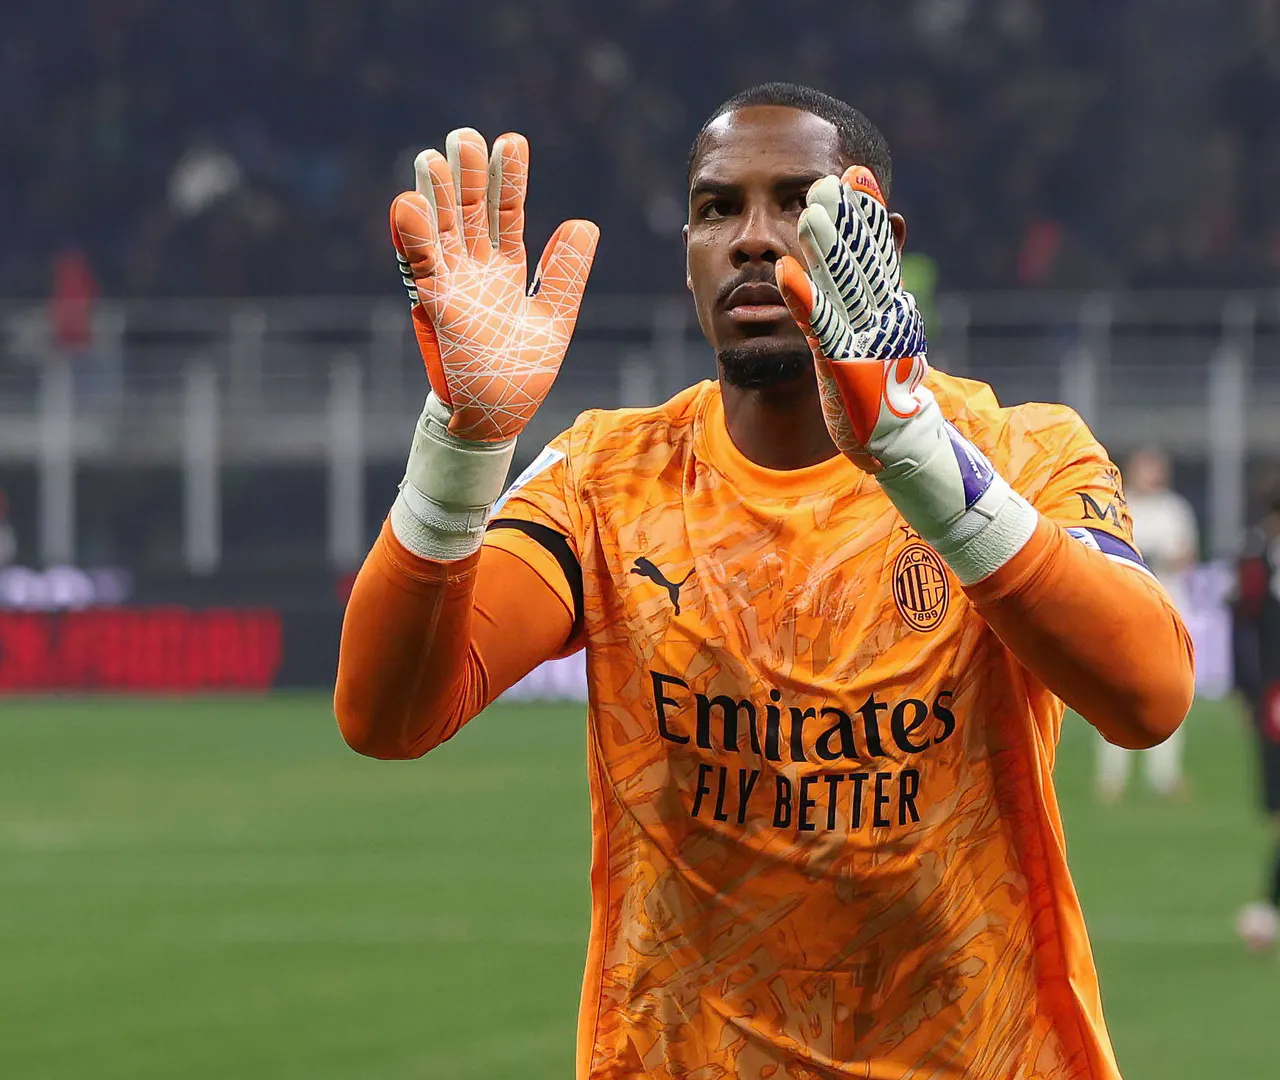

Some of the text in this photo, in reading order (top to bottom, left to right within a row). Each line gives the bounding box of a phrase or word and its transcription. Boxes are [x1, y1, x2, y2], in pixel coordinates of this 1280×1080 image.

[903, 551, 933, 570] ACM
[912, 609, 938, 621] 1899
[650, 670, 956, 762] Emirates
[691, 764, 920, 832] FLY BETTER
